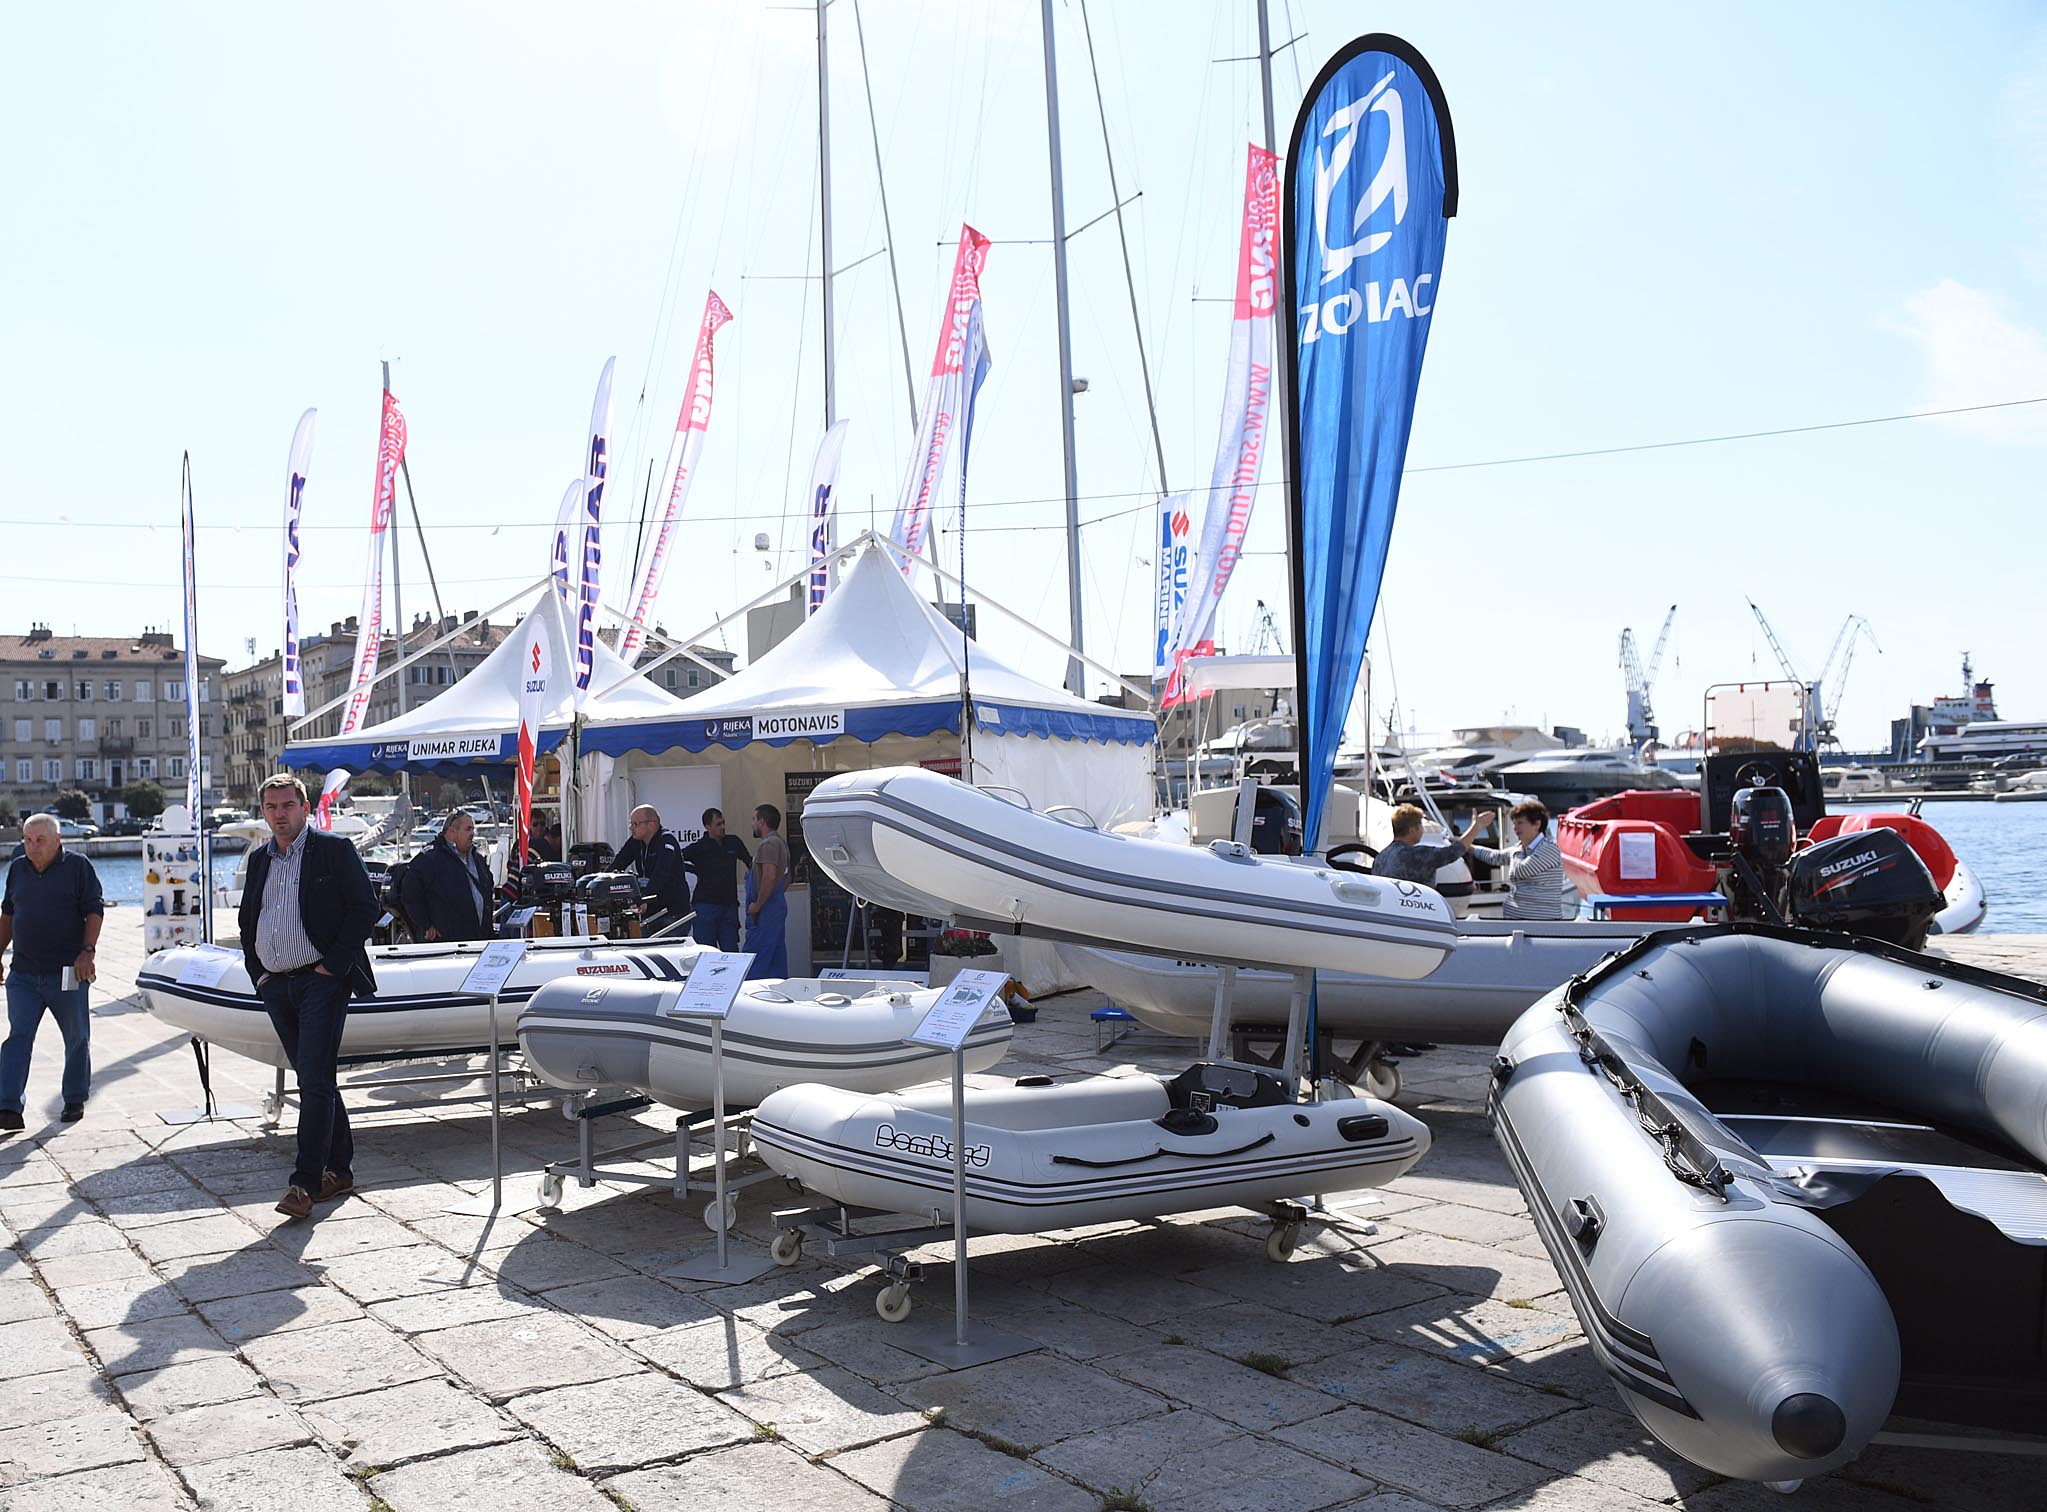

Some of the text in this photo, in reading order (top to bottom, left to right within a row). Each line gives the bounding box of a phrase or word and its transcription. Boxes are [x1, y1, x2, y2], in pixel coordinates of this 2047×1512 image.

[1159, 547, 1171, 631] MARINE
[526, 679, 546, 693] SUZUKI
[723, 720, 751, 732] RIJEKA
[758, 714, 839, 734] MOTONAVIS
[385, 744, 408, 754] RIJEKA
[412, 738, 496, 756] UNIMAR RIJEKA
[788, 778, 813, 786] SUZUKI
[678, 830, 700, 842] Life!
[1820, 850, 1878, 877] SUZUKI
[544, 872, 572, 880] SUZUKI
[1399, 899, 1436, 911] ZODIAC
[576, 965, 630, 975] SUZUMAR
